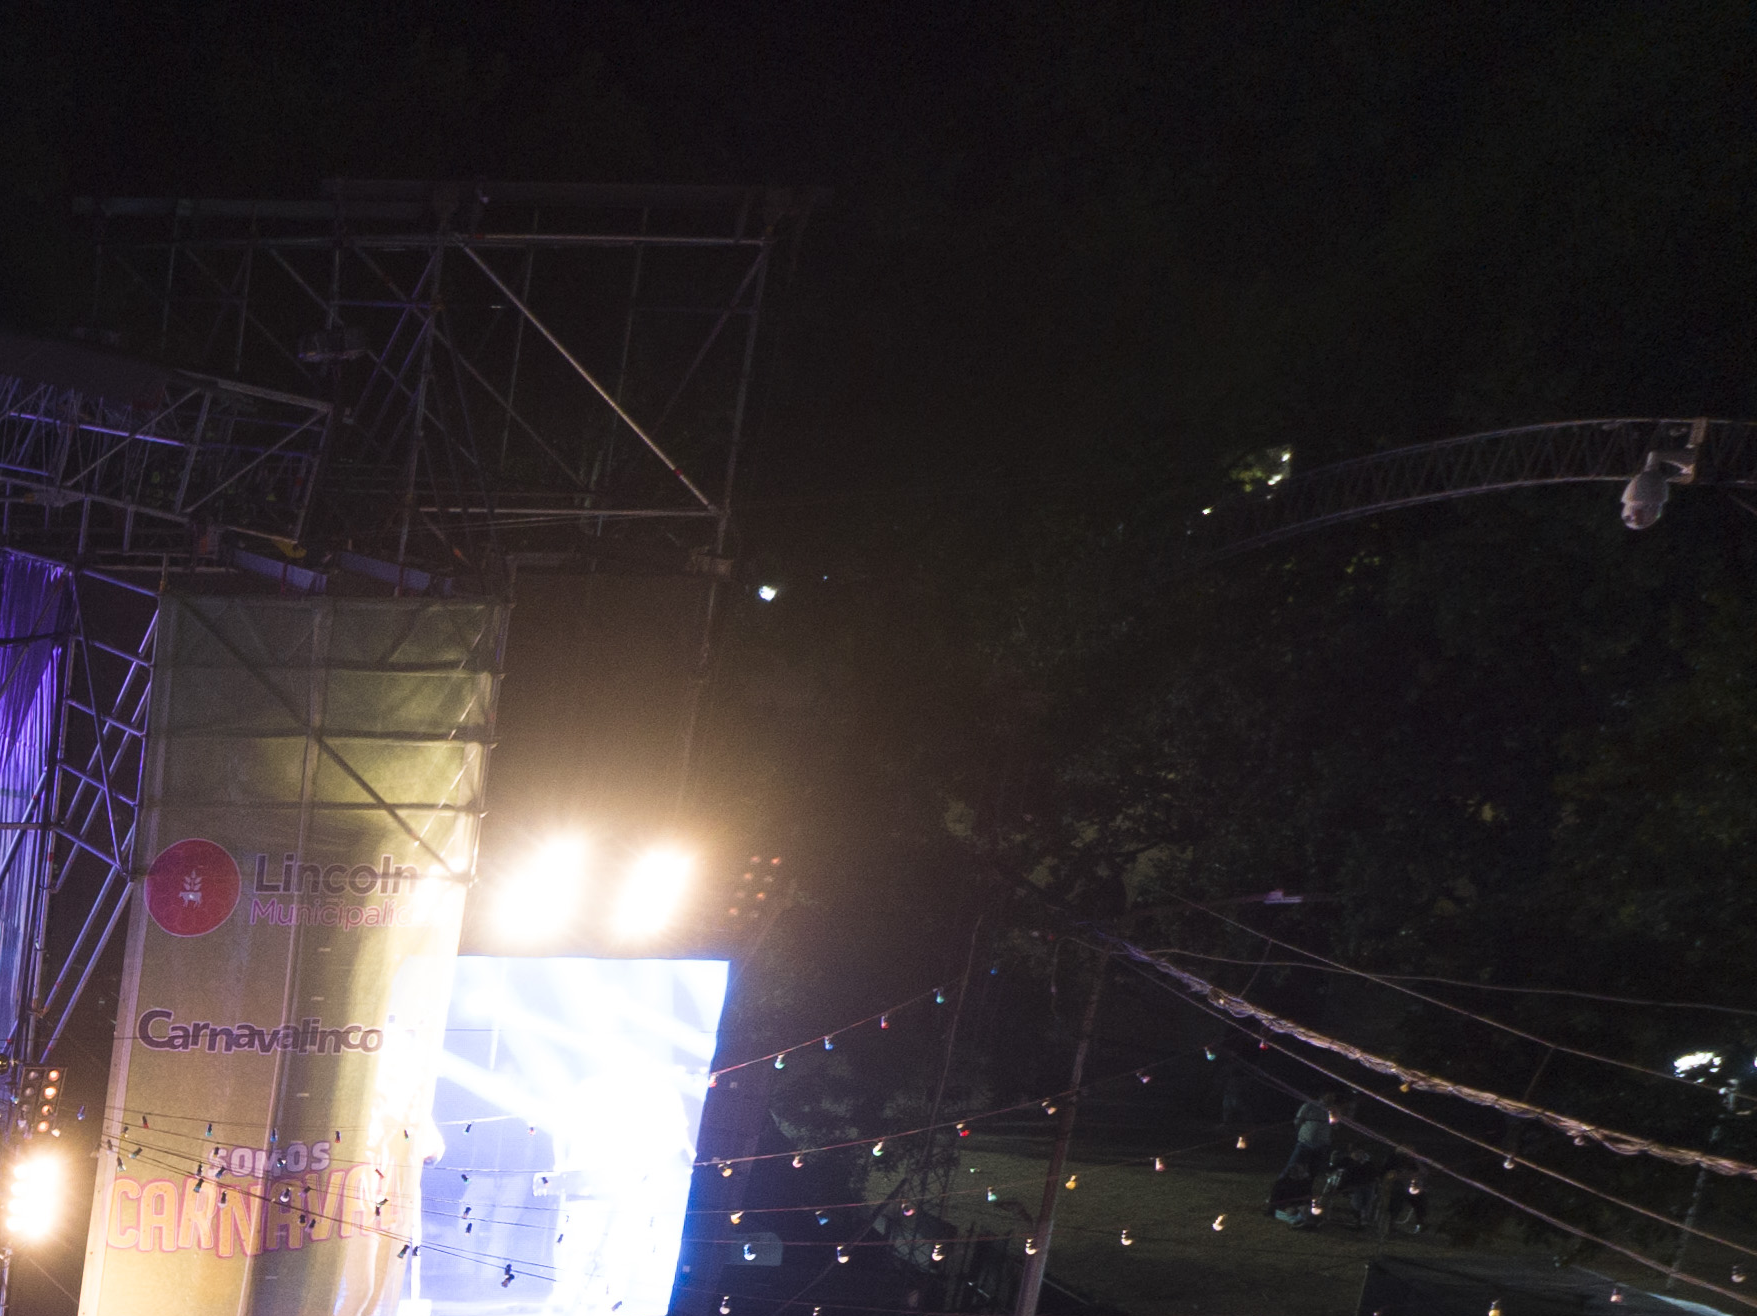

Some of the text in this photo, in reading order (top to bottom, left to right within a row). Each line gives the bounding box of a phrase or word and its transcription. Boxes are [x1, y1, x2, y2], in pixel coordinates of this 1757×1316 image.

[254, 853, 418, 896] Lincoln
[137, 1007, 386, 1055] Carnavalinco
[208, 1141, 331, 1179] SOMOS
